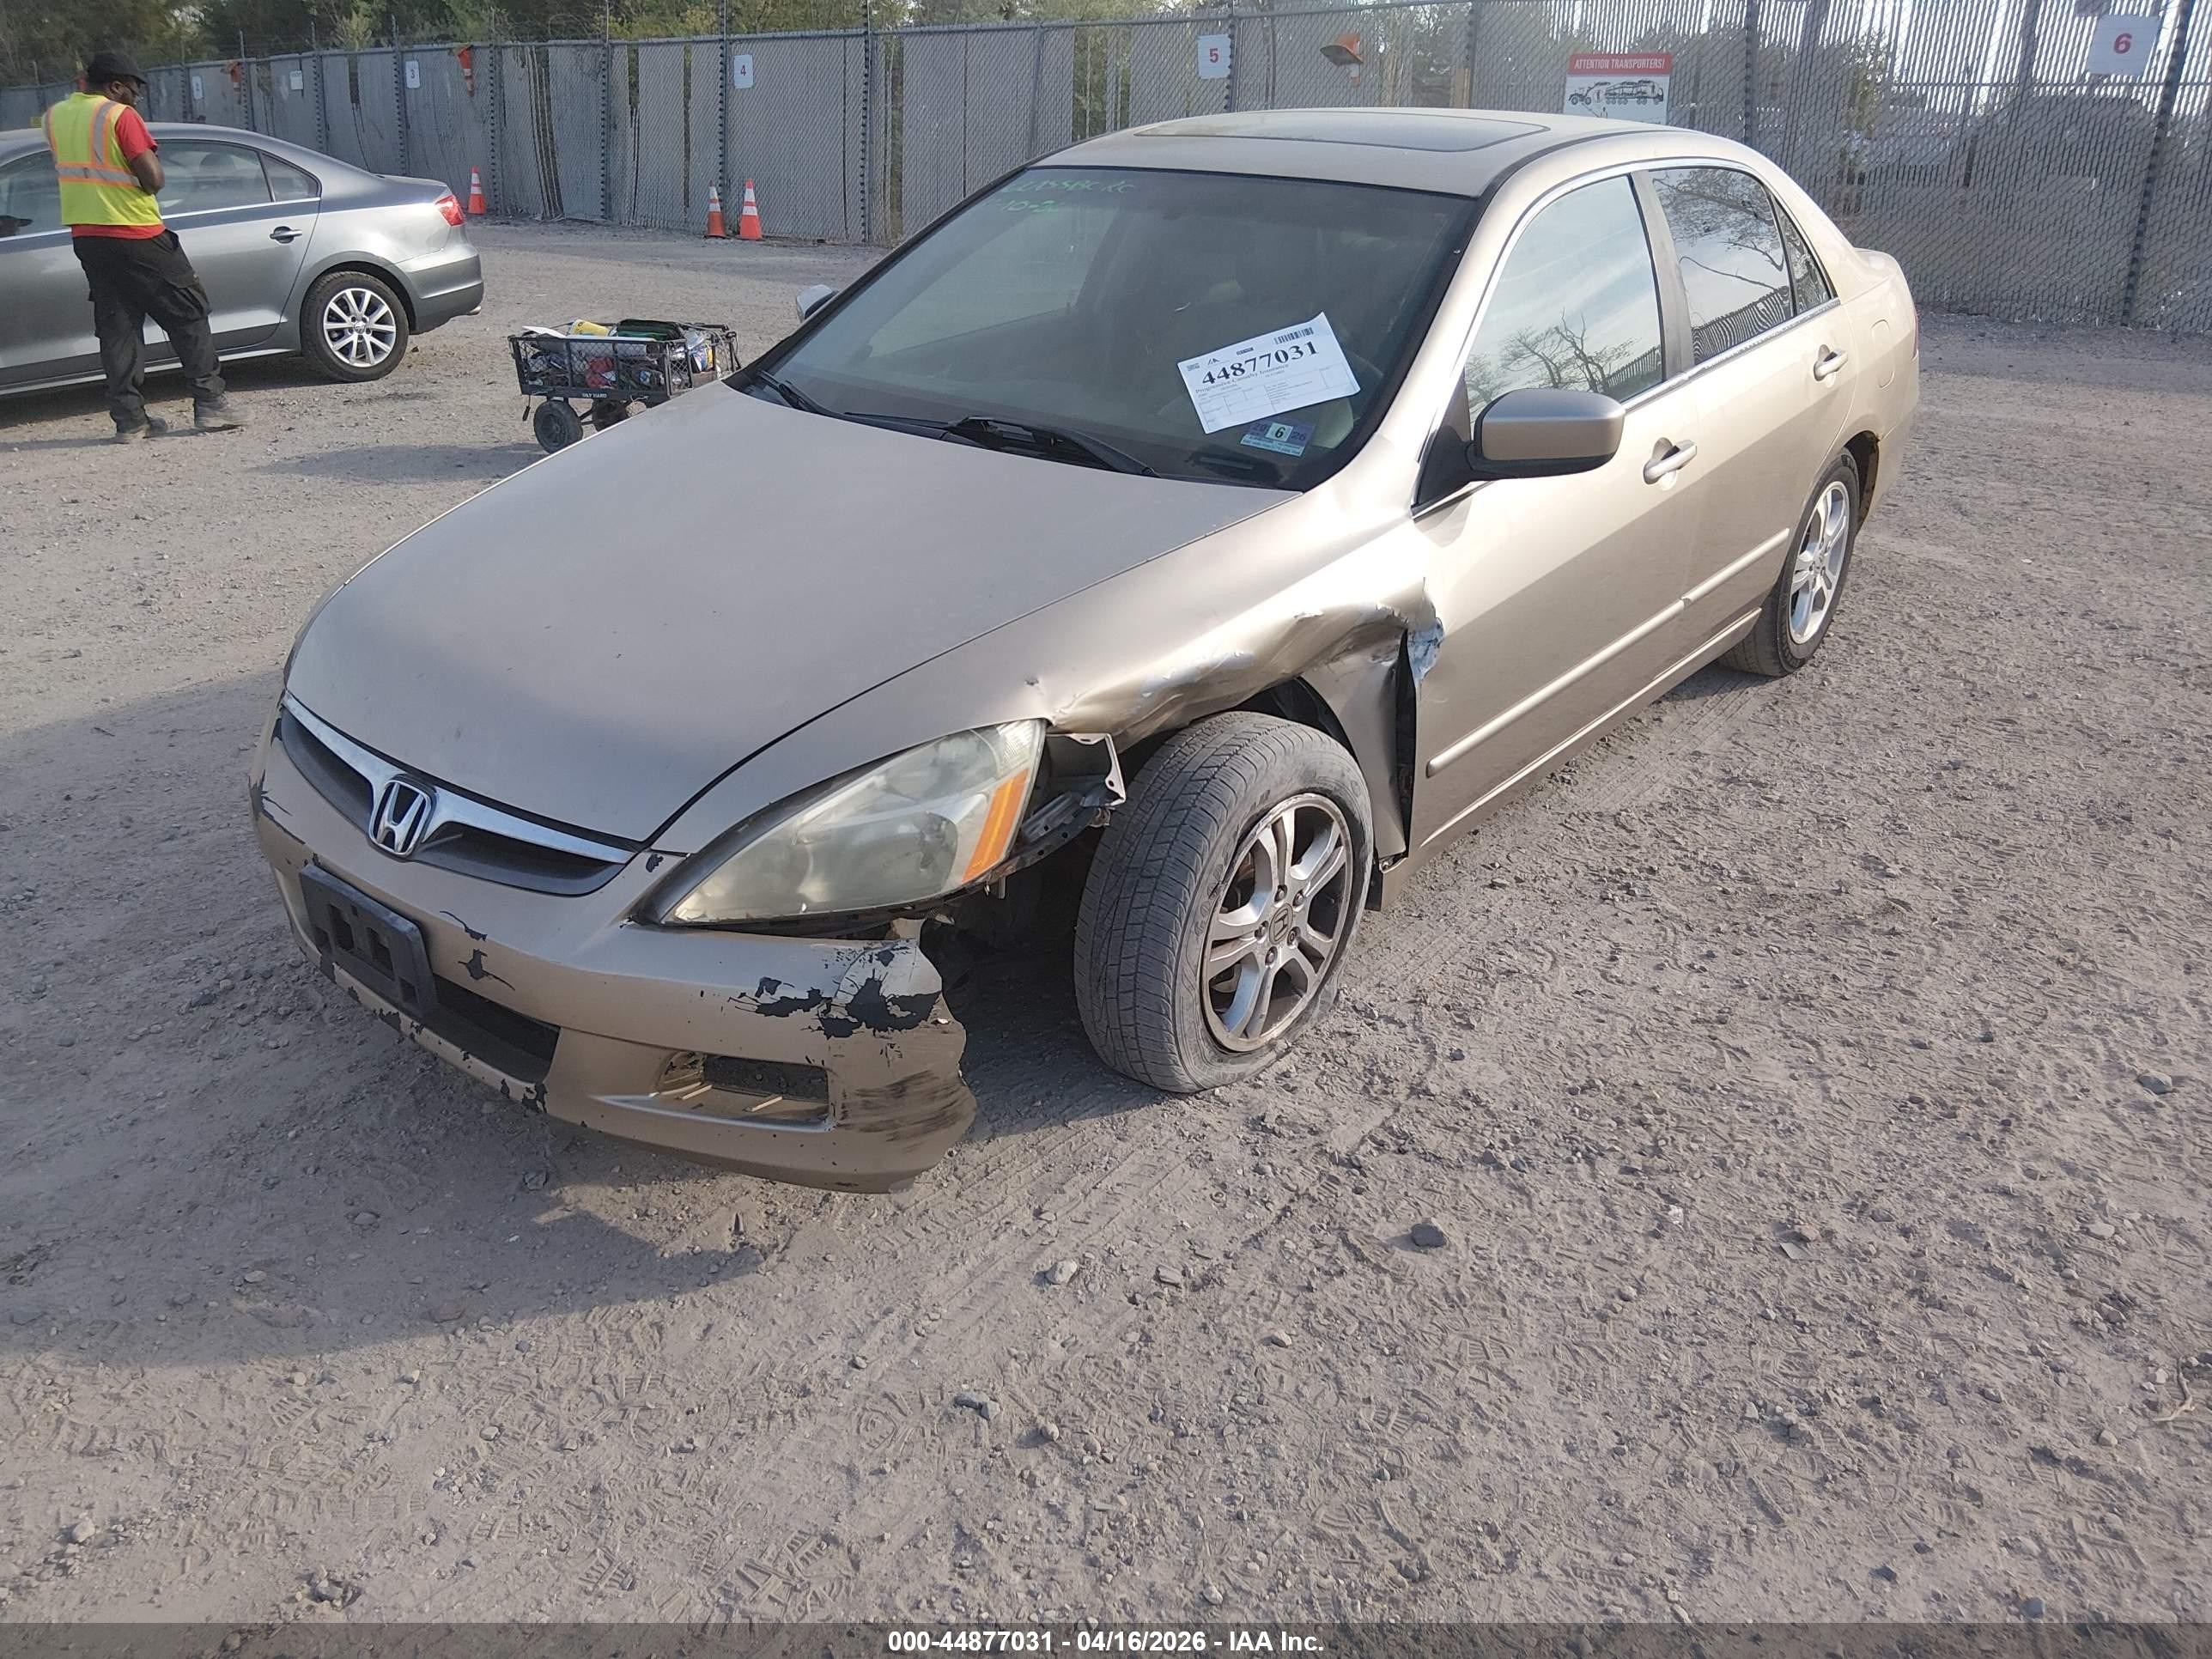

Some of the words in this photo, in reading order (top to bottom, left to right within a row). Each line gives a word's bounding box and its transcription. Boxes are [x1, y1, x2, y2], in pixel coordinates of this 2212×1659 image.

[2113, 33, 2132, 54] 6
[1209, 47, 1219, 64] 5
[740, 64, 747, 76] 4
[1574, 58, 1610, 70] ATTENTION
[1611, 58, 1666, 70] TRANSPORTERS!
[410, 69, 416, 79] 3
[1202, 341, 1318, 385] 44877031
[1274, 426, 1286, 439] 6
[1291, 430, 1306, 441] 26
